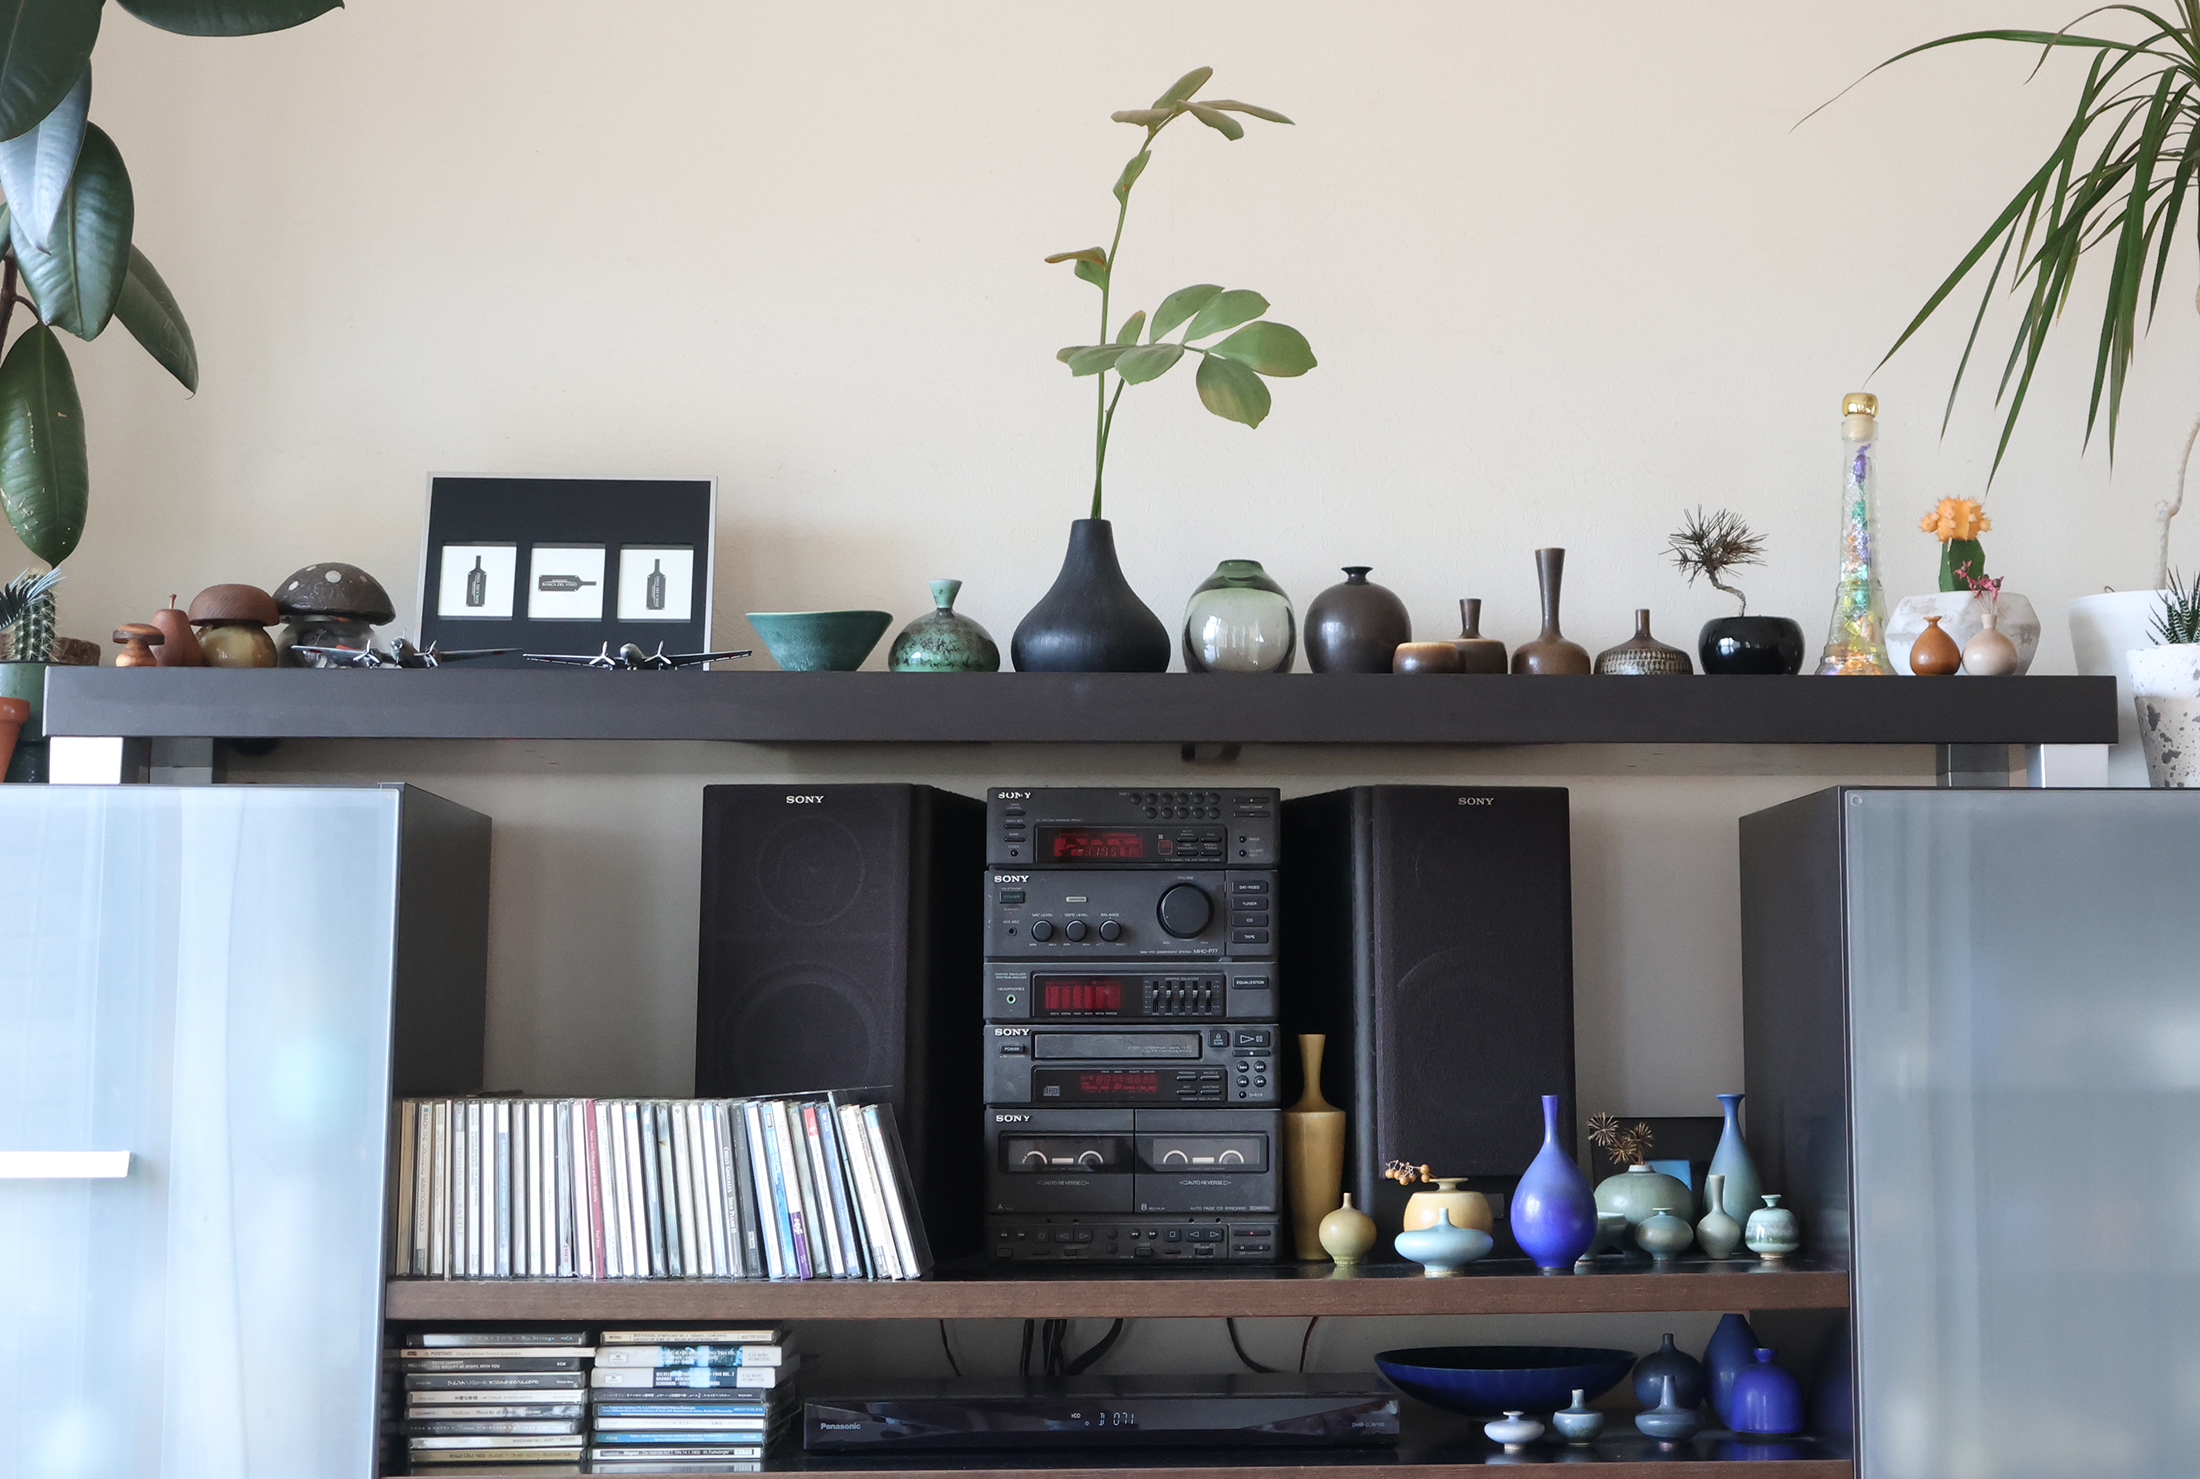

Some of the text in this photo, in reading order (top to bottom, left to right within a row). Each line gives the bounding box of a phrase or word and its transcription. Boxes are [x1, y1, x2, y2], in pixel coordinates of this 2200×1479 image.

[997, 791, 1032, 799] SONY
[786, 796, 824, 804] SONY
[1458, 797, 1494, 806] SONY
[994, 875, 1030, 883] SONY
[994, 1028, 1030, 1036] SONY
[995, 1114, 1031, 1122] SONY
[724, 1165, 732, 1192] GONZALES
[728, 1210, 736, 1227] PIANO
[1141, 1203, 1147, 1211] B
[1113, 1412, 1134, 1426] 071
[820, 1422, 861, 1430] Panasonic
